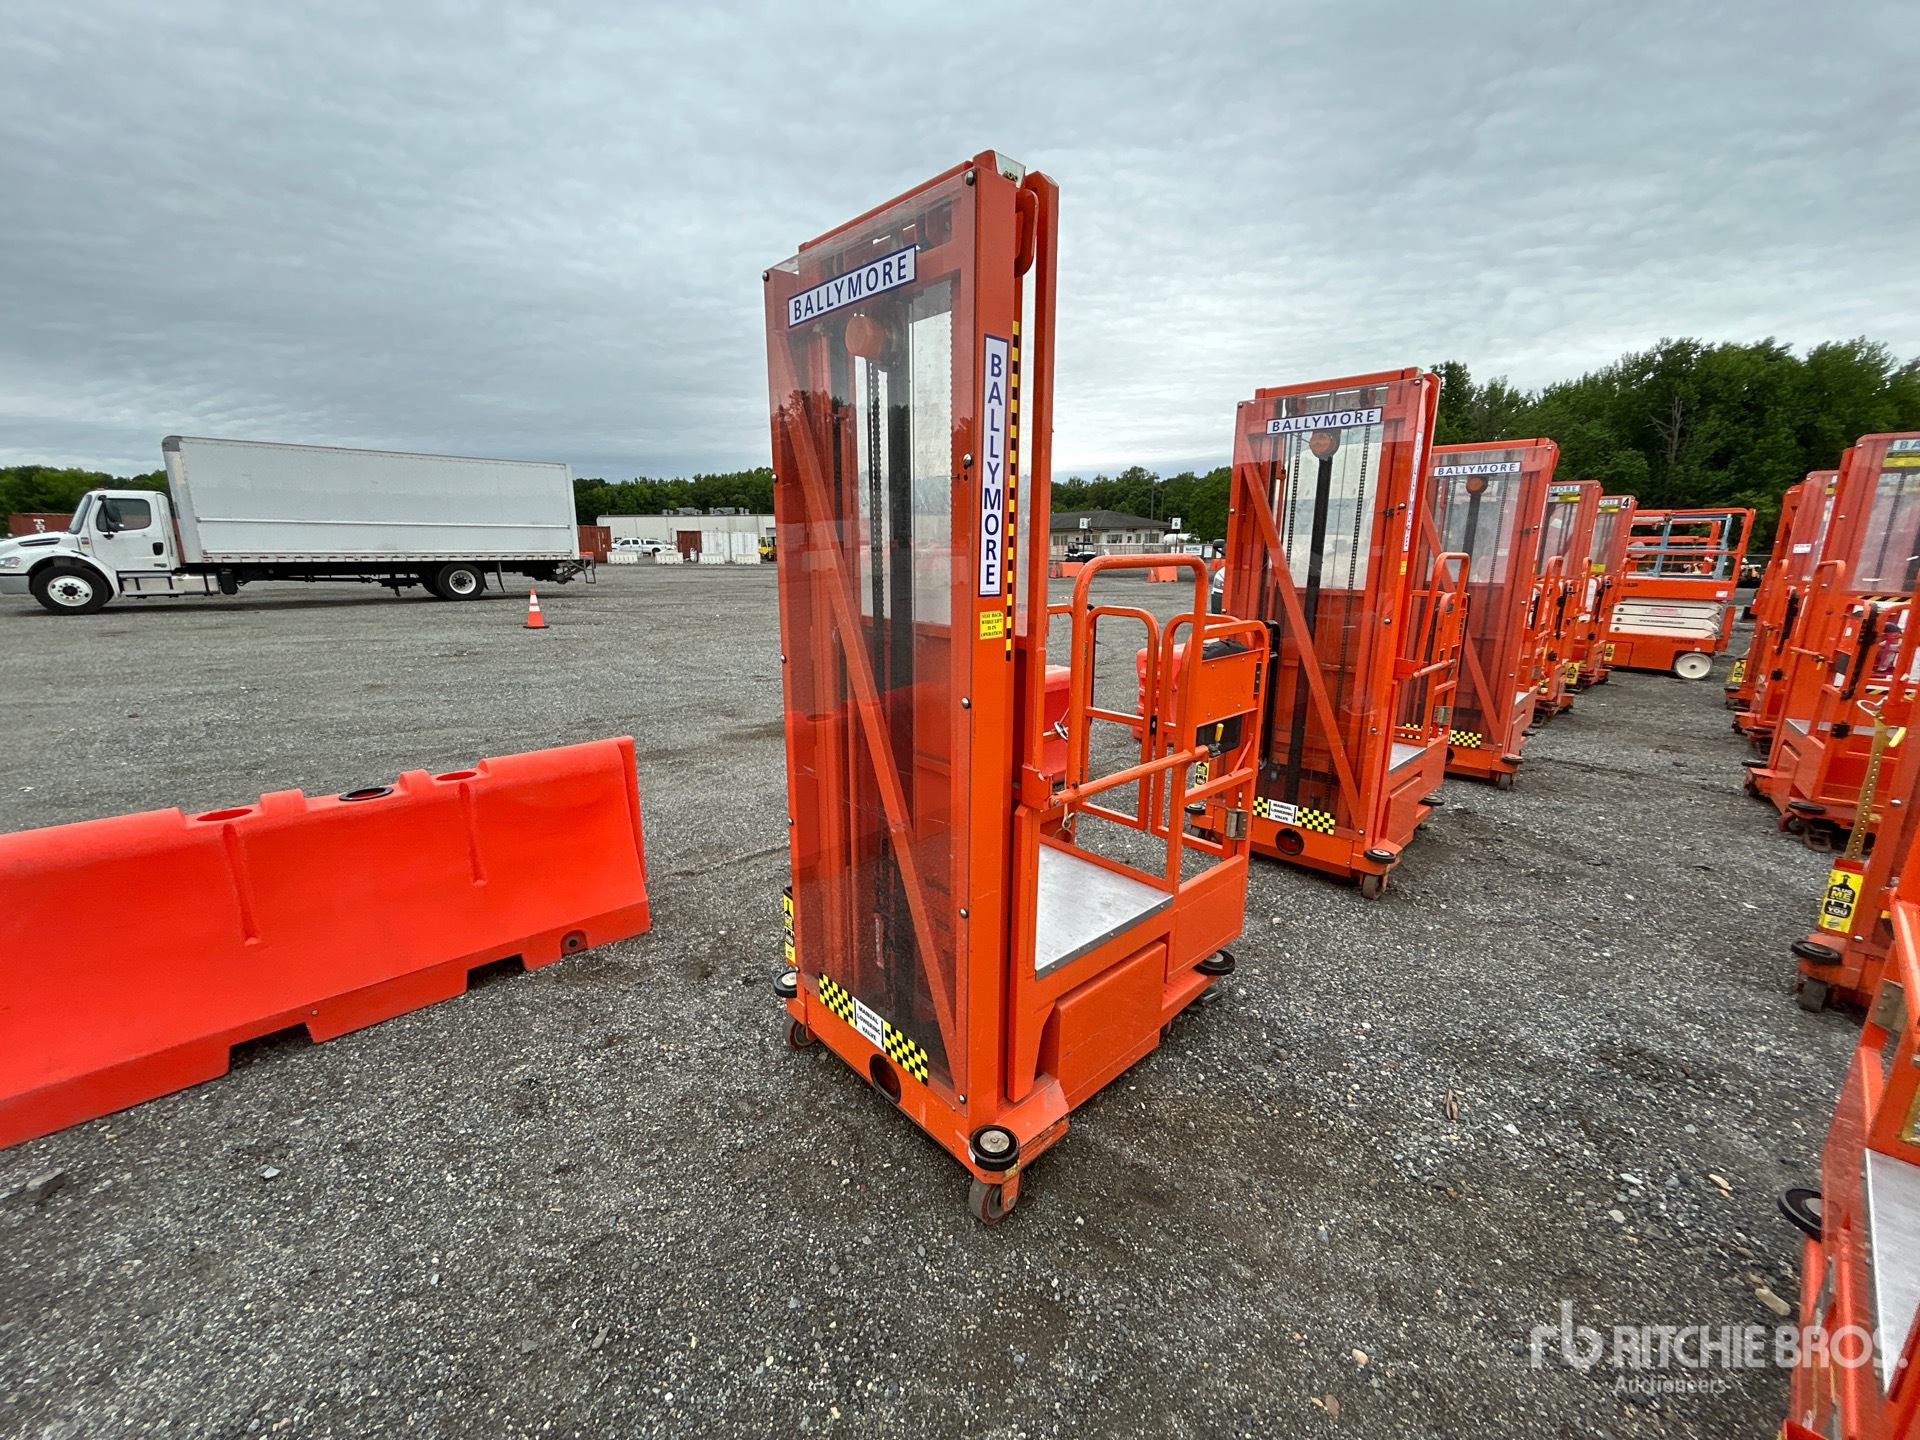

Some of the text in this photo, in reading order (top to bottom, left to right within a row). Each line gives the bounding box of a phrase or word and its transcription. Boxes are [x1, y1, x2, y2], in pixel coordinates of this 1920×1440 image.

[793, 254, 907, 321] BALLYMORE
[1272, 410, 1375, 432] BALLYMORE
[984, 353, 1002, 586] BALLYMORE
[1438, 463, 1516, 475] BALLYMORE
[1622, 498, 1630, 508] 4
[1271, 808, 1293, 817] LOWERING
[1273, 803, 1292, 811] MANUAL
[1831, 889, 1852, 899] ME
[1828, 906, 1848, 915] YOU
[858, 1005, 879, 1025] MANUAL
[857, 1012, 881, 1036] LOWERING
[861, 1025, 877, 1041] VALVE
